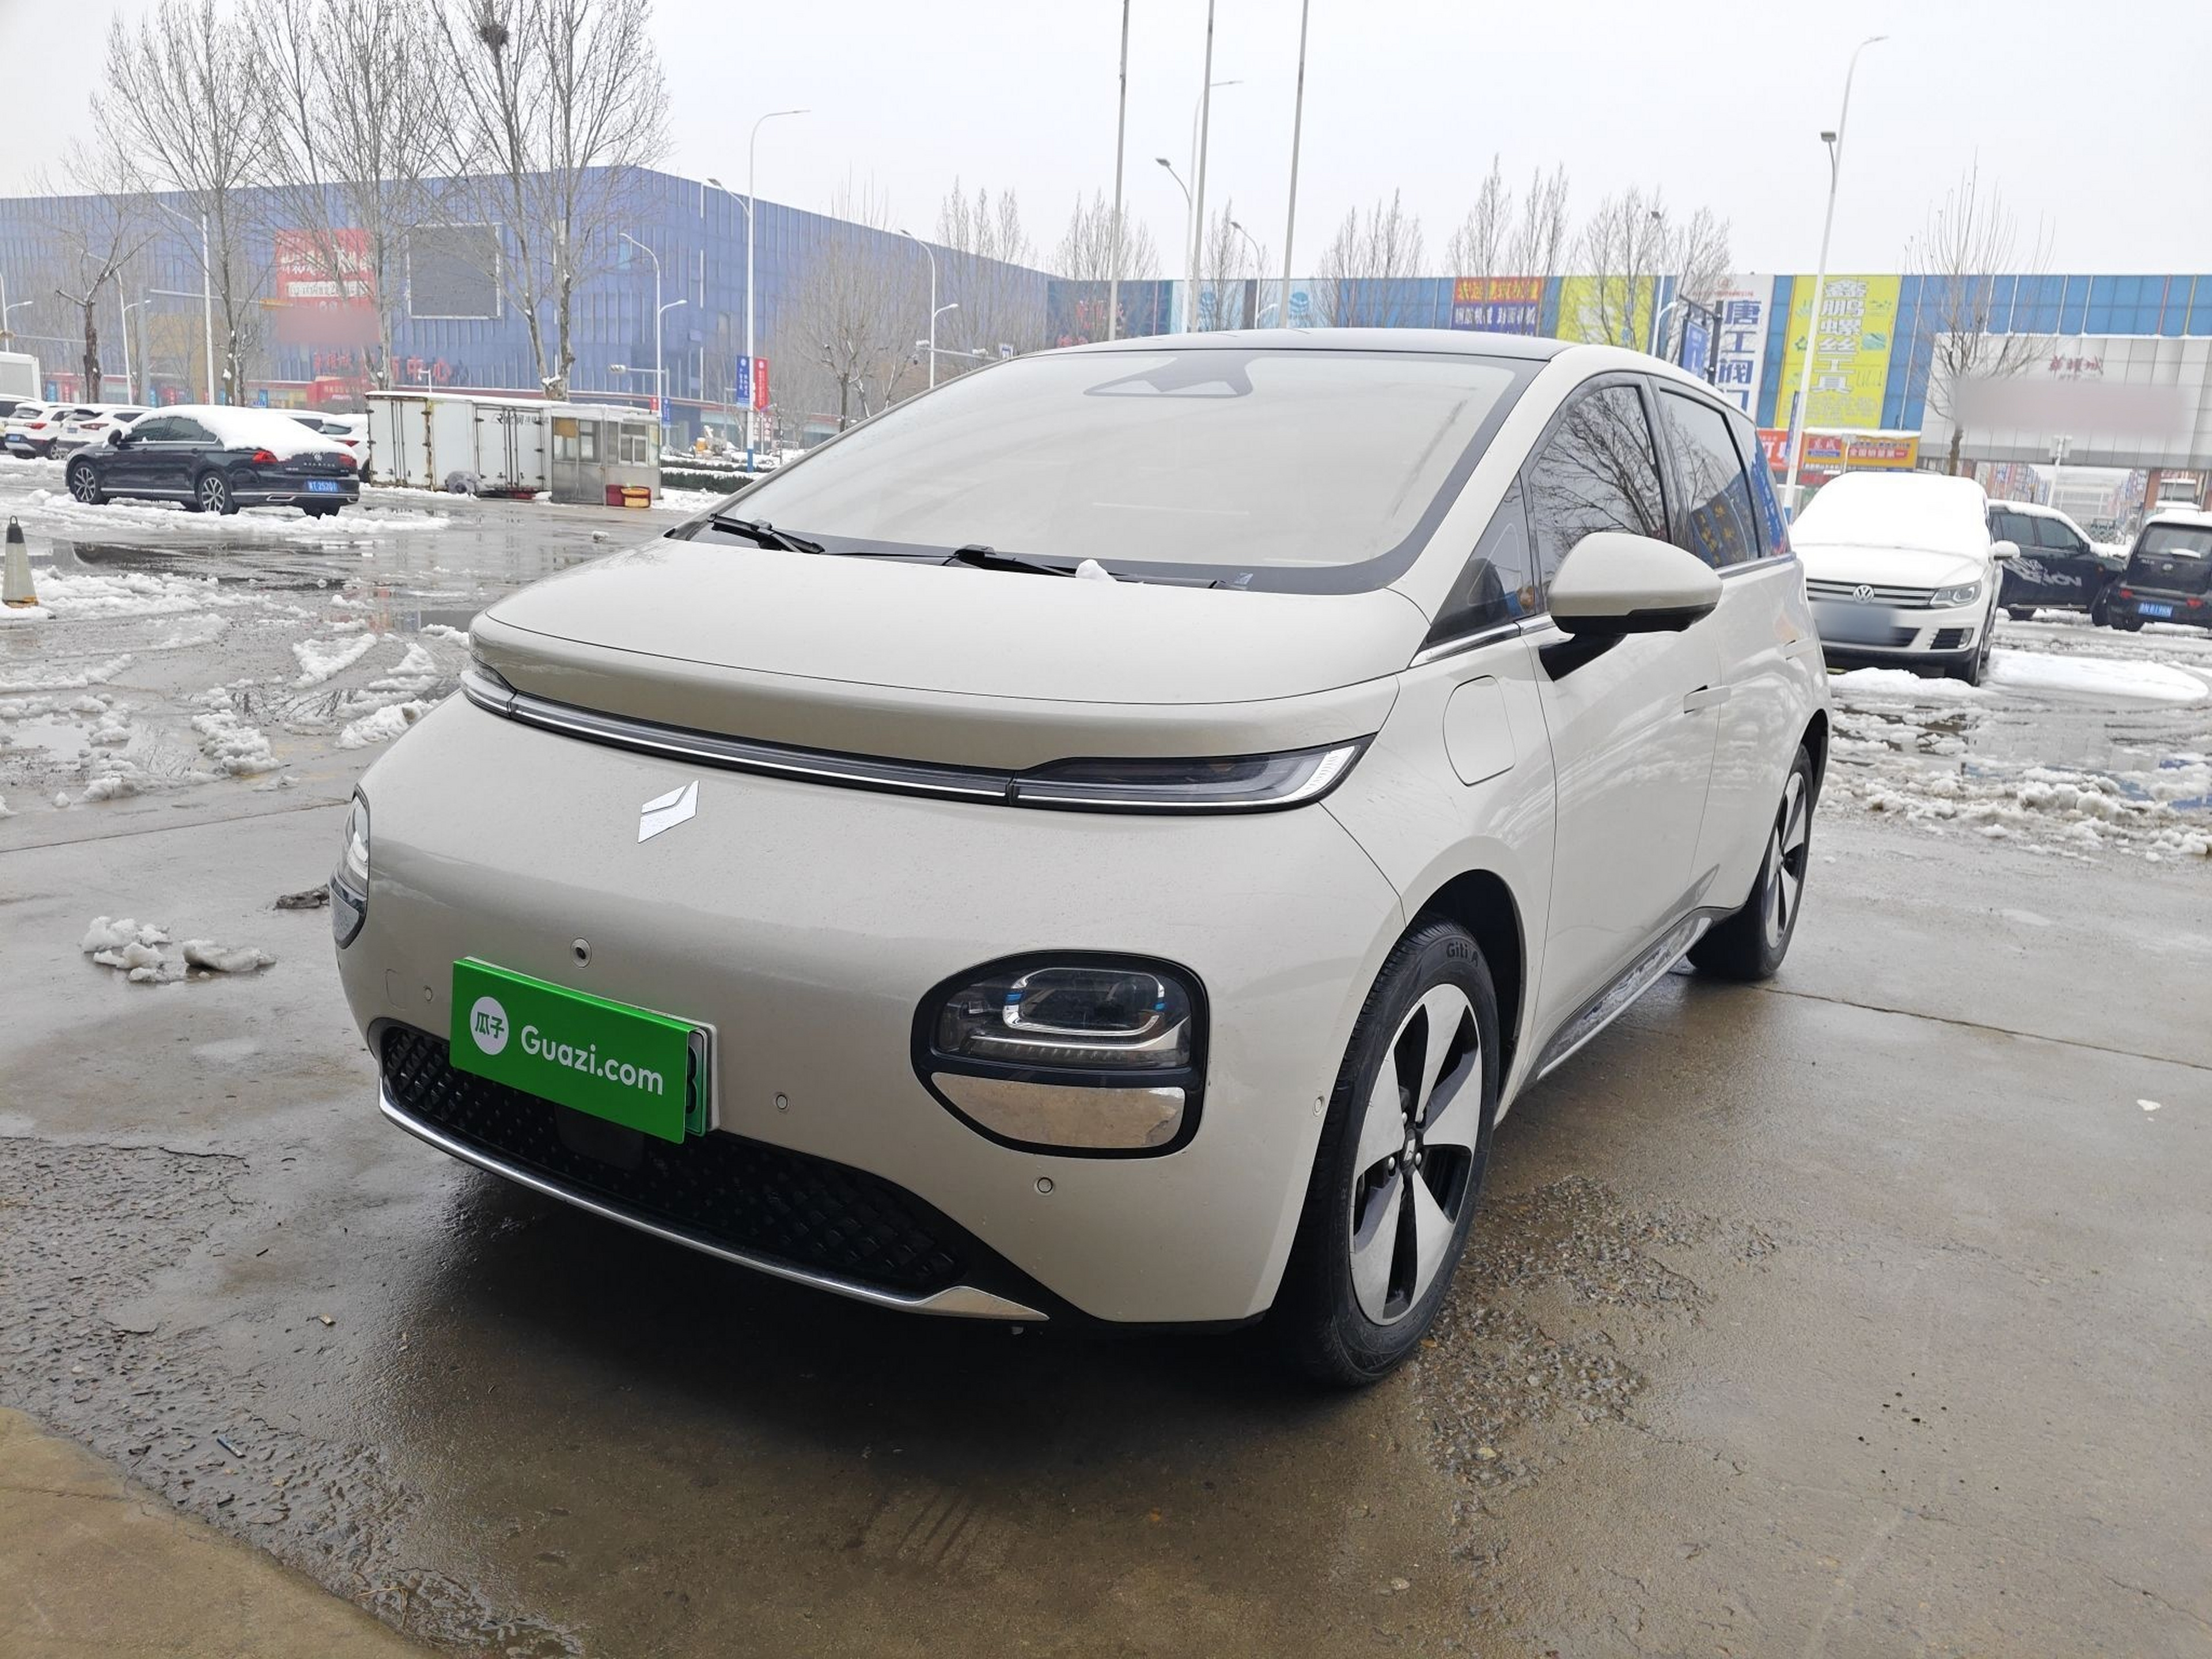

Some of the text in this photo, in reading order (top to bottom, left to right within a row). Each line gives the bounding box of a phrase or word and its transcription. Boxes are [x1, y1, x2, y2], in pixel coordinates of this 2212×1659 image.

[1446, 941, 1468, 959] Giti
[475, 1011, 505, 1039] 瓜子
[521, 1025, 664, 1095] Guazi.com
